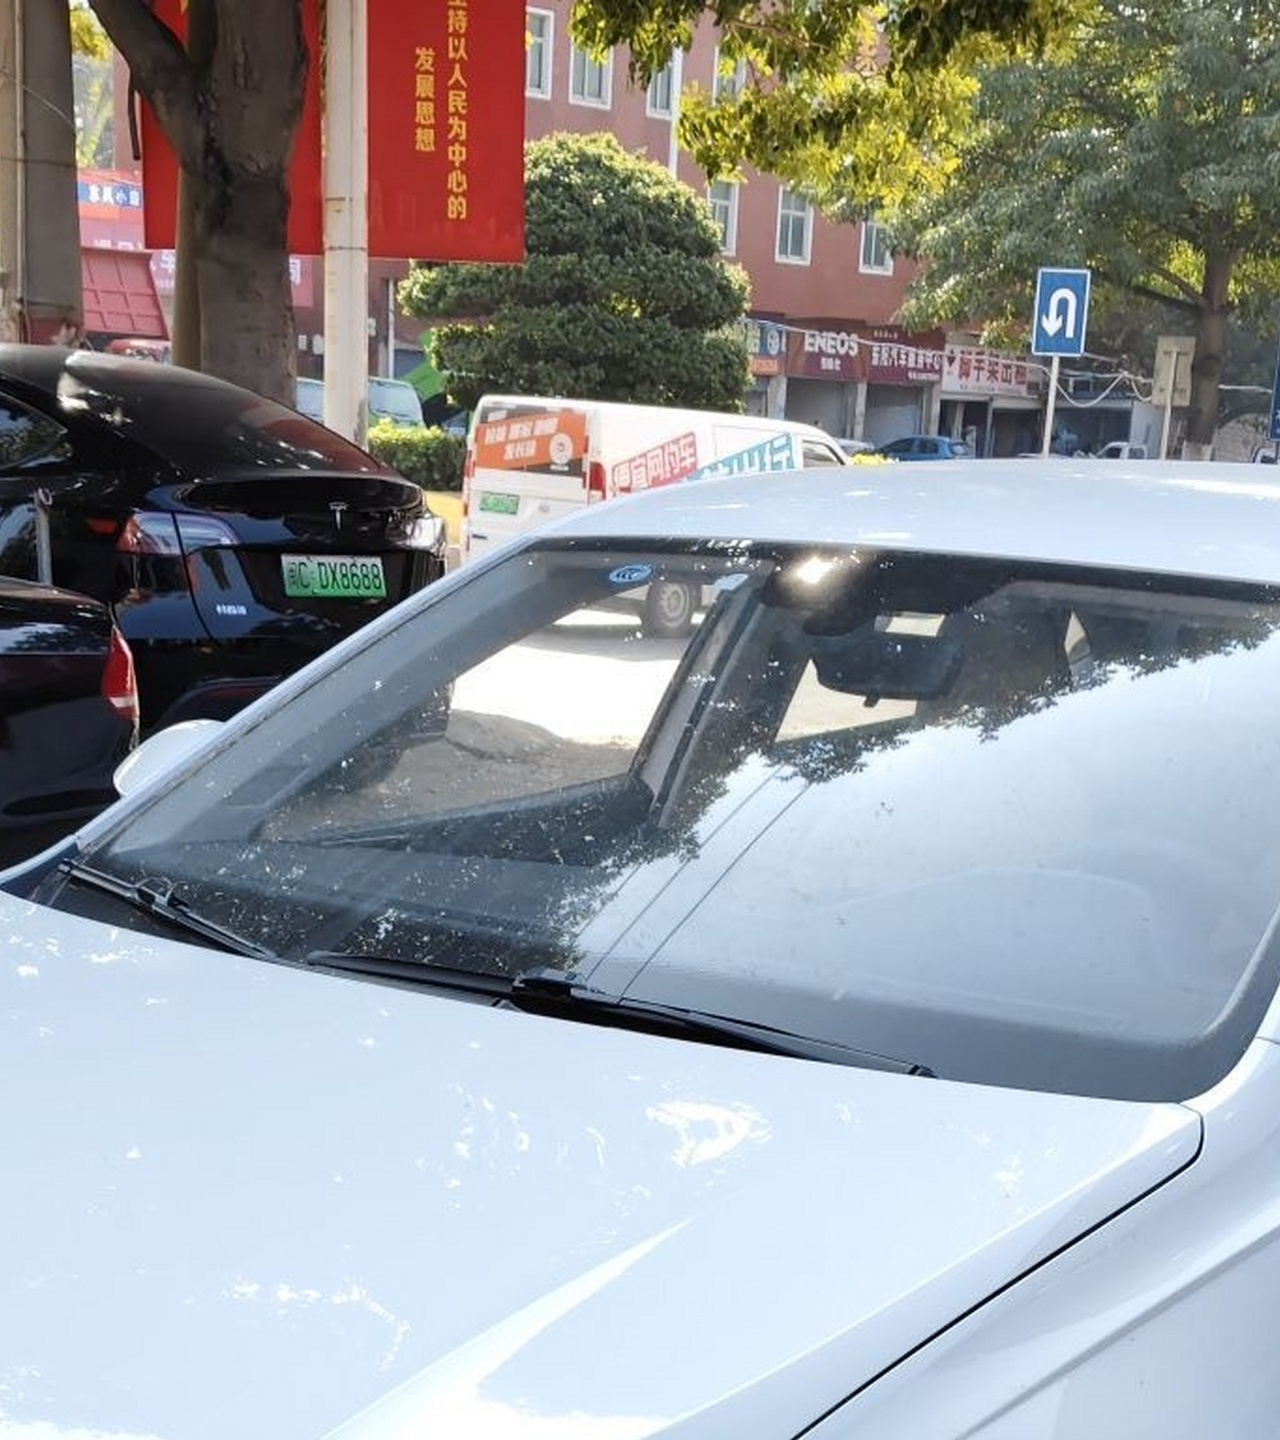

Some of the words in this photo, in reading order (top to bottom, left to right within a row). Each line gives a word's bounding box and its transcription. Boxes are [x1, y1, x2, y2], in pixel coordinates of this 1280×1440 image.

[414, 47, 435, 151] 发展思想
[804, 331, 858, 357] ENEOS
[318, 562, 382, 589] DX8688
